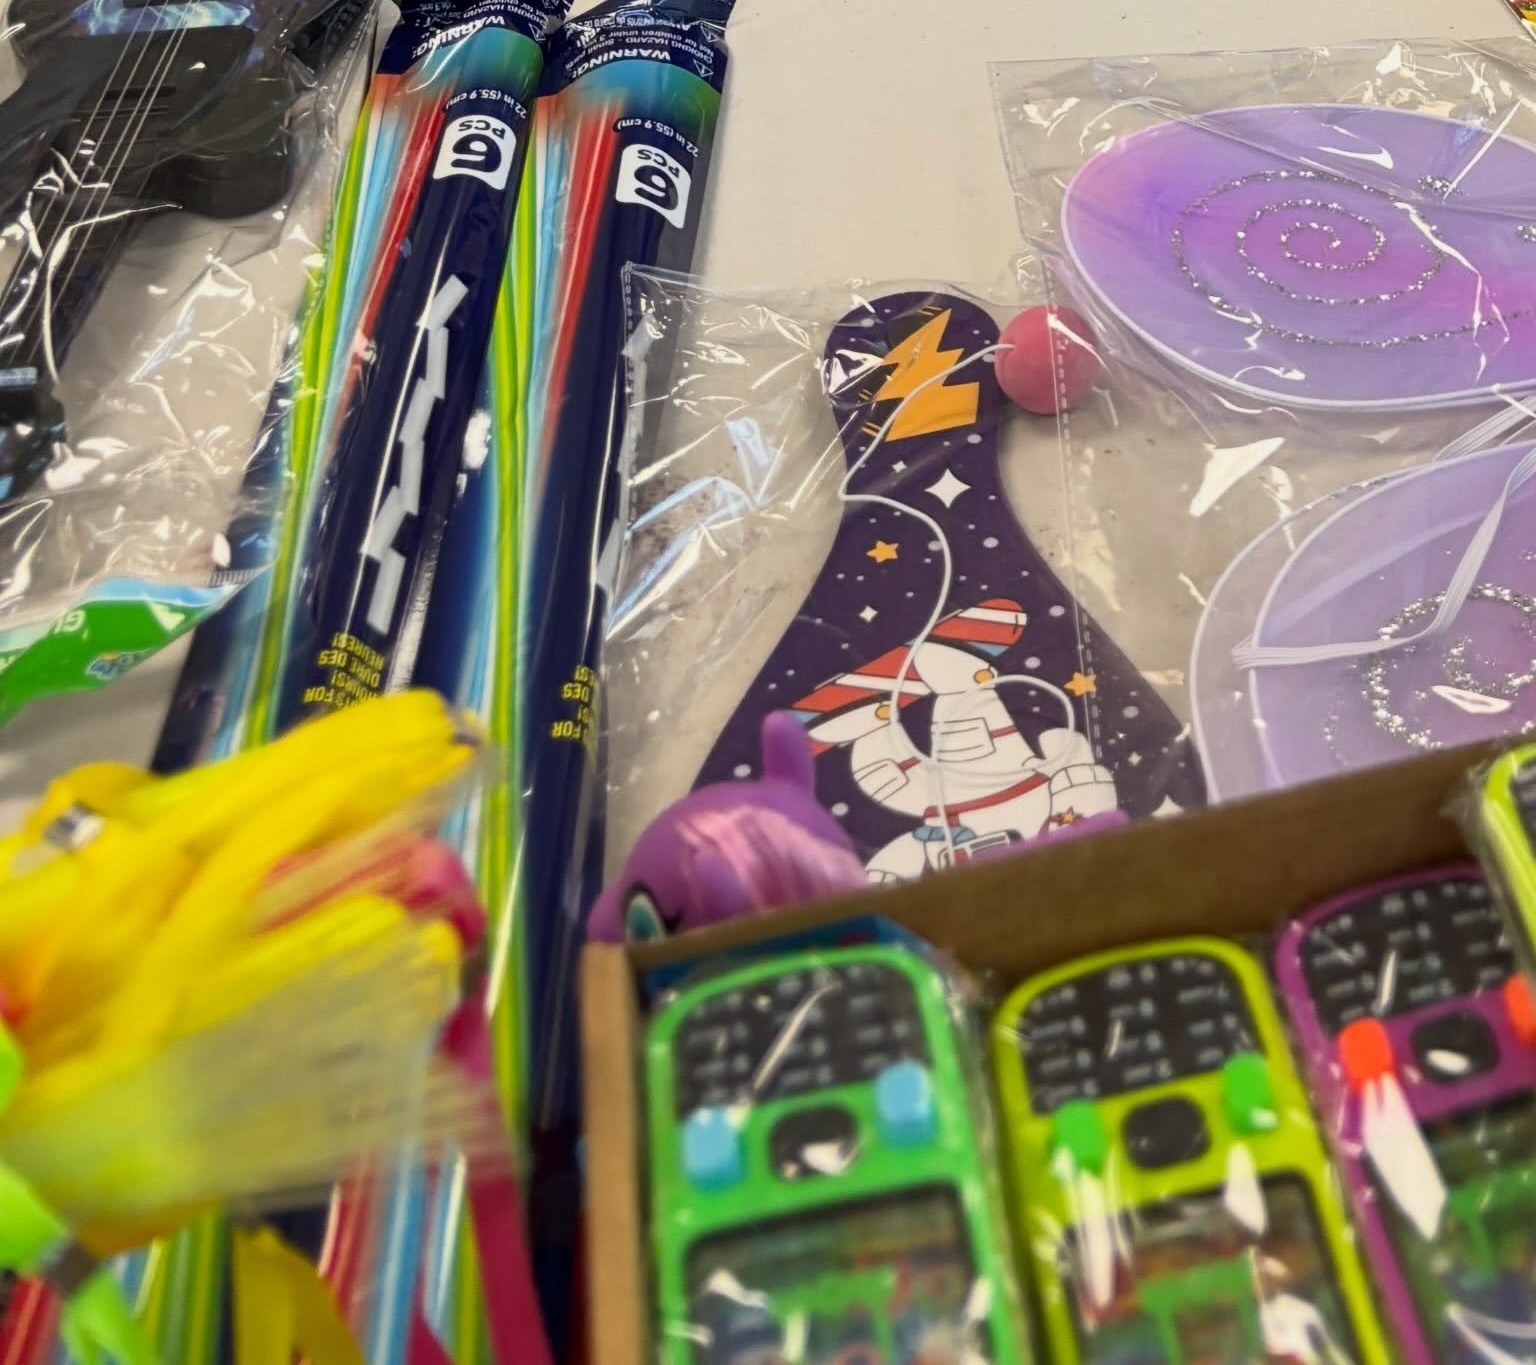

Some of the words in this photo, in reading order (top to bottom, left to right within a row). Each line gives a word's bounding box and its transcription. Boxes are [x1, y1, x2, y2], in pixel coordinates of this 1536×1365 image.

[412, 16, 505, 59] WARNING:
[625, 36, 669, 46] HAZARD
[671, 41, 713, 64] CHOKING
[572, 49, 671, 78] WARNING:
[446, 93, 467, 109] cm)
[469, 89, 502, 100] (55.9
[503, 94, 514, 108] in
[515, 102, 527, 118] 22
[458, 120, 506, 140] PCS
[618, 118, 642, 130] cm)
[644, 120, 674, 137] (55.9
[676, 133, 685, 146] in
[451, 133, 502, 173] 6
[686, 143, 699, 157] 22
[637, 149, 680, 179] PCS
[634, 165, 679, 211] 6
[318, 650, 347, 667] DES
[303, 686, 334, 703] FOR
[563, 683, 589, 703] DES
[552, 720, 581, 739] FOR
